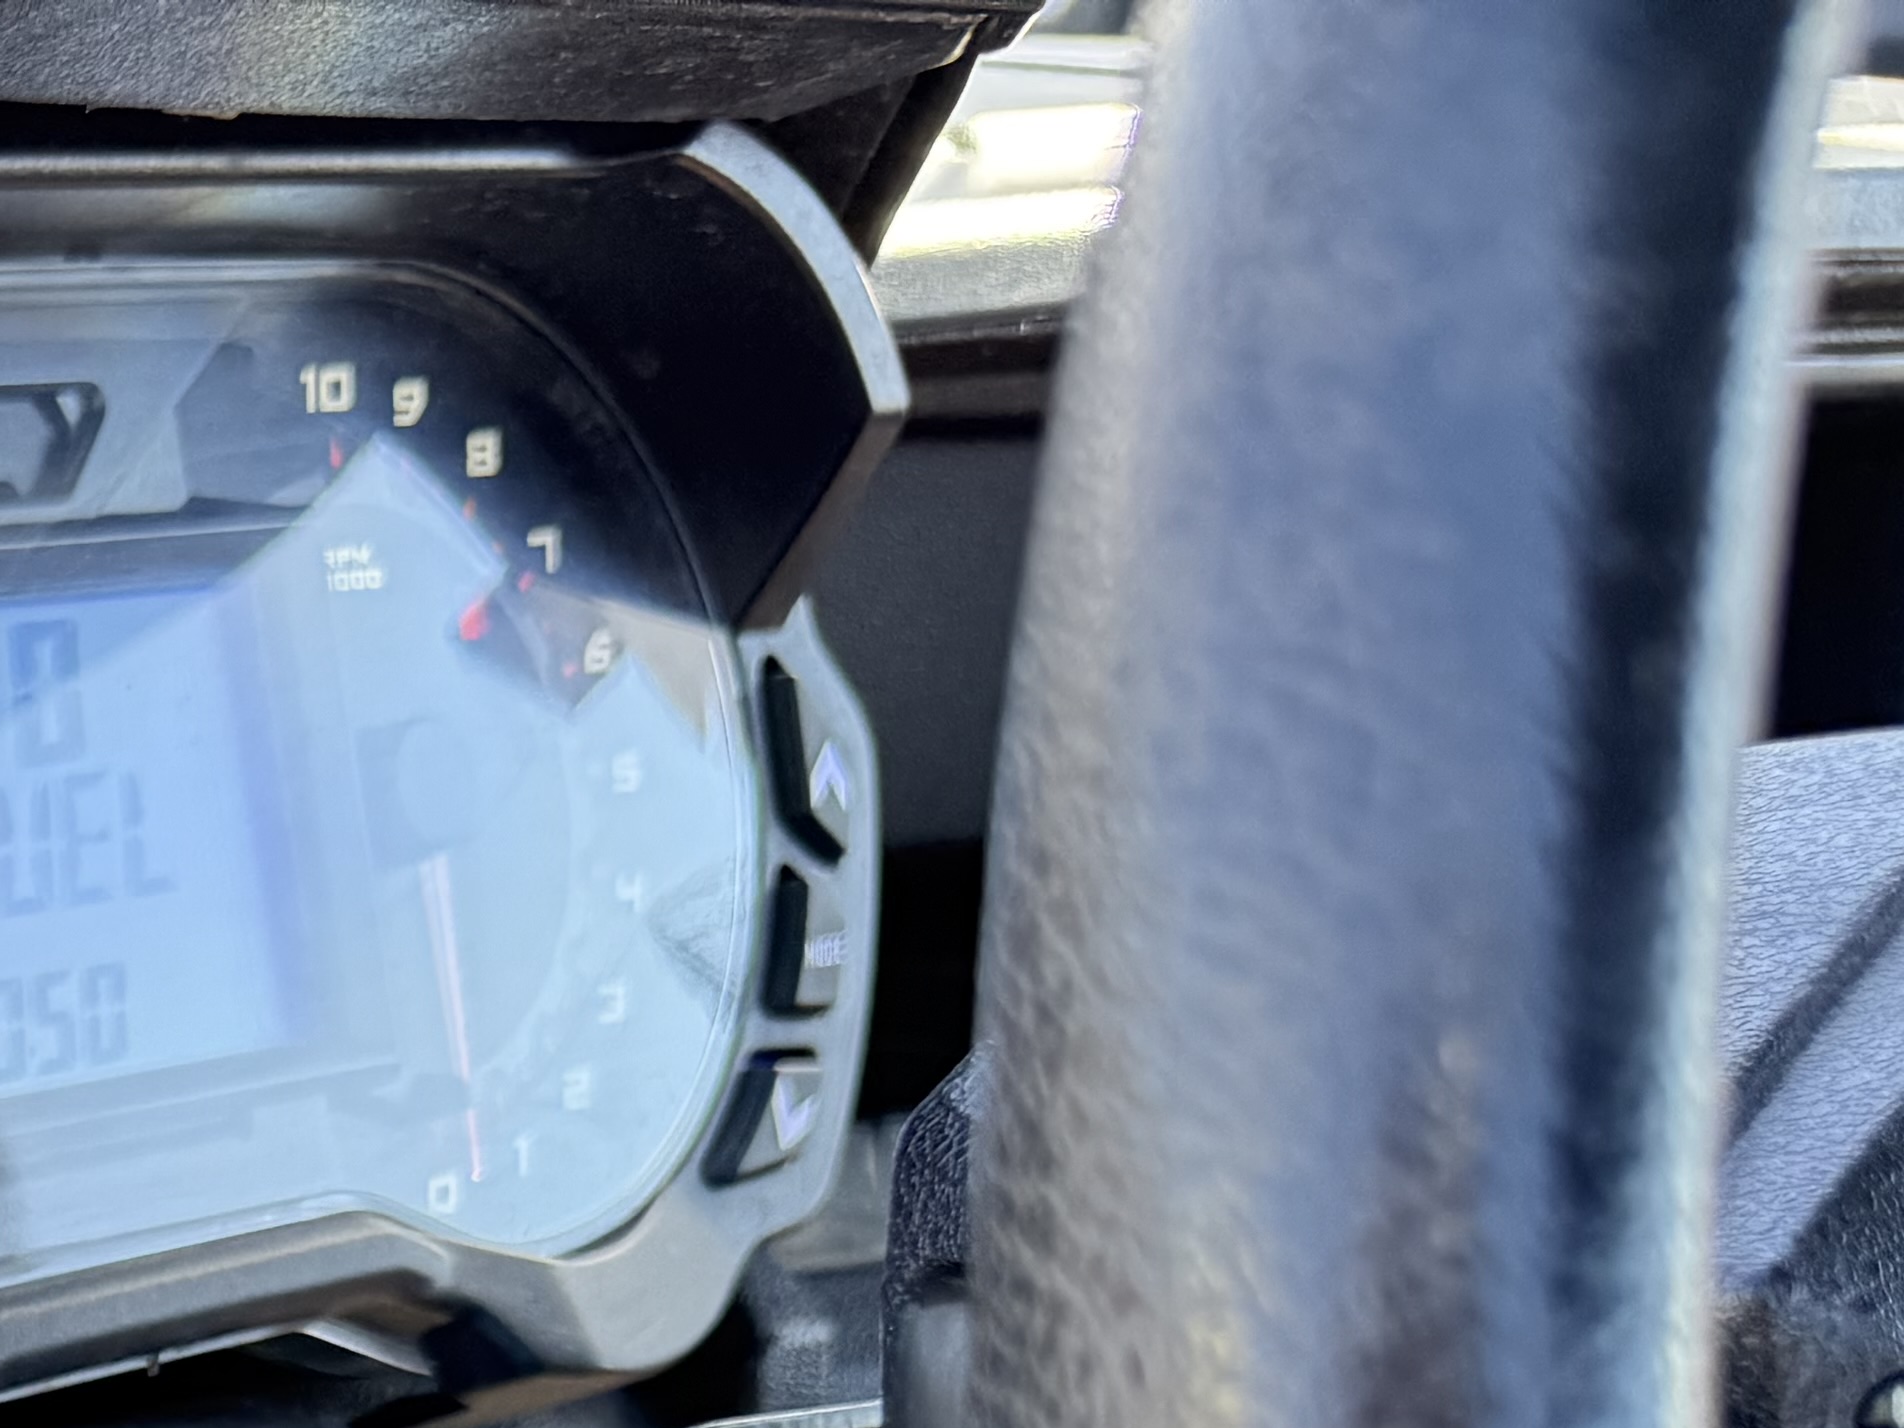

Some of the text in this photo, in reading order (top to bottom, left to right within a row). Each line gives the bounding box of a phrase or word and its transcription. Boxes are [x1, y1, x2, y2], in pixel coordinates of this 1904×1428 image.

[300, 361, 357, 414] 10
[392, 375, 429, 427] 9
[465, 427, 503, 478] 8
[527, 525, 562, 574] 7
[615, 870, 644, 913] 4
[562, 1068, 592, 1110] 2
[512, 1133, 532, 1176] 1
[428, 1171, 459, 1213] 0
